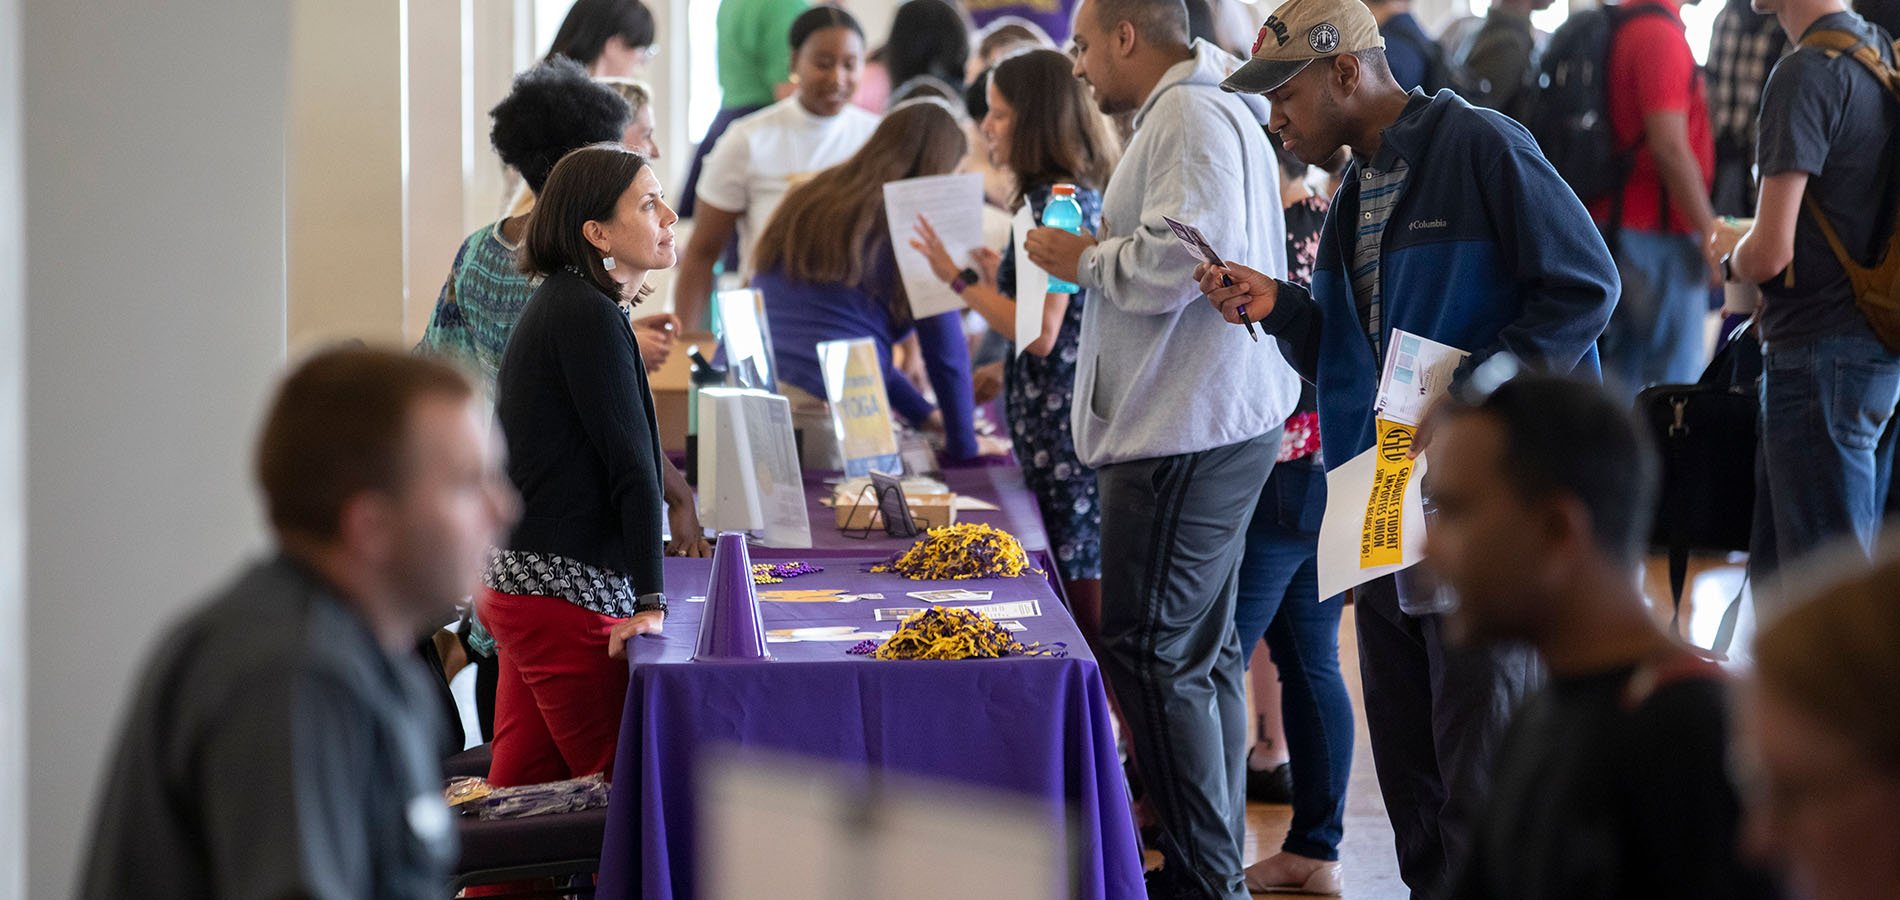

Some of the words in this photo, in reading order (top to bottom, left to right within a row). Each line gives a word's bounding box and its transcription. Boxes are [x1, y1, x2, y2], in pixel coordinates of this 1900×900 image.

[1413, 218, 1447, 230] Columbia
[1376, 473, 1397, 516] EMPLOYEES
[1390, 467, 1409, 507] GRADUATE
[1364, 506, 1375, 531] BECAUSE
[1373, 517, 1387, 548] UNION
[1386, 508, 1399, 550] STUDENT
[1362, 532, 1371, 544] WE
